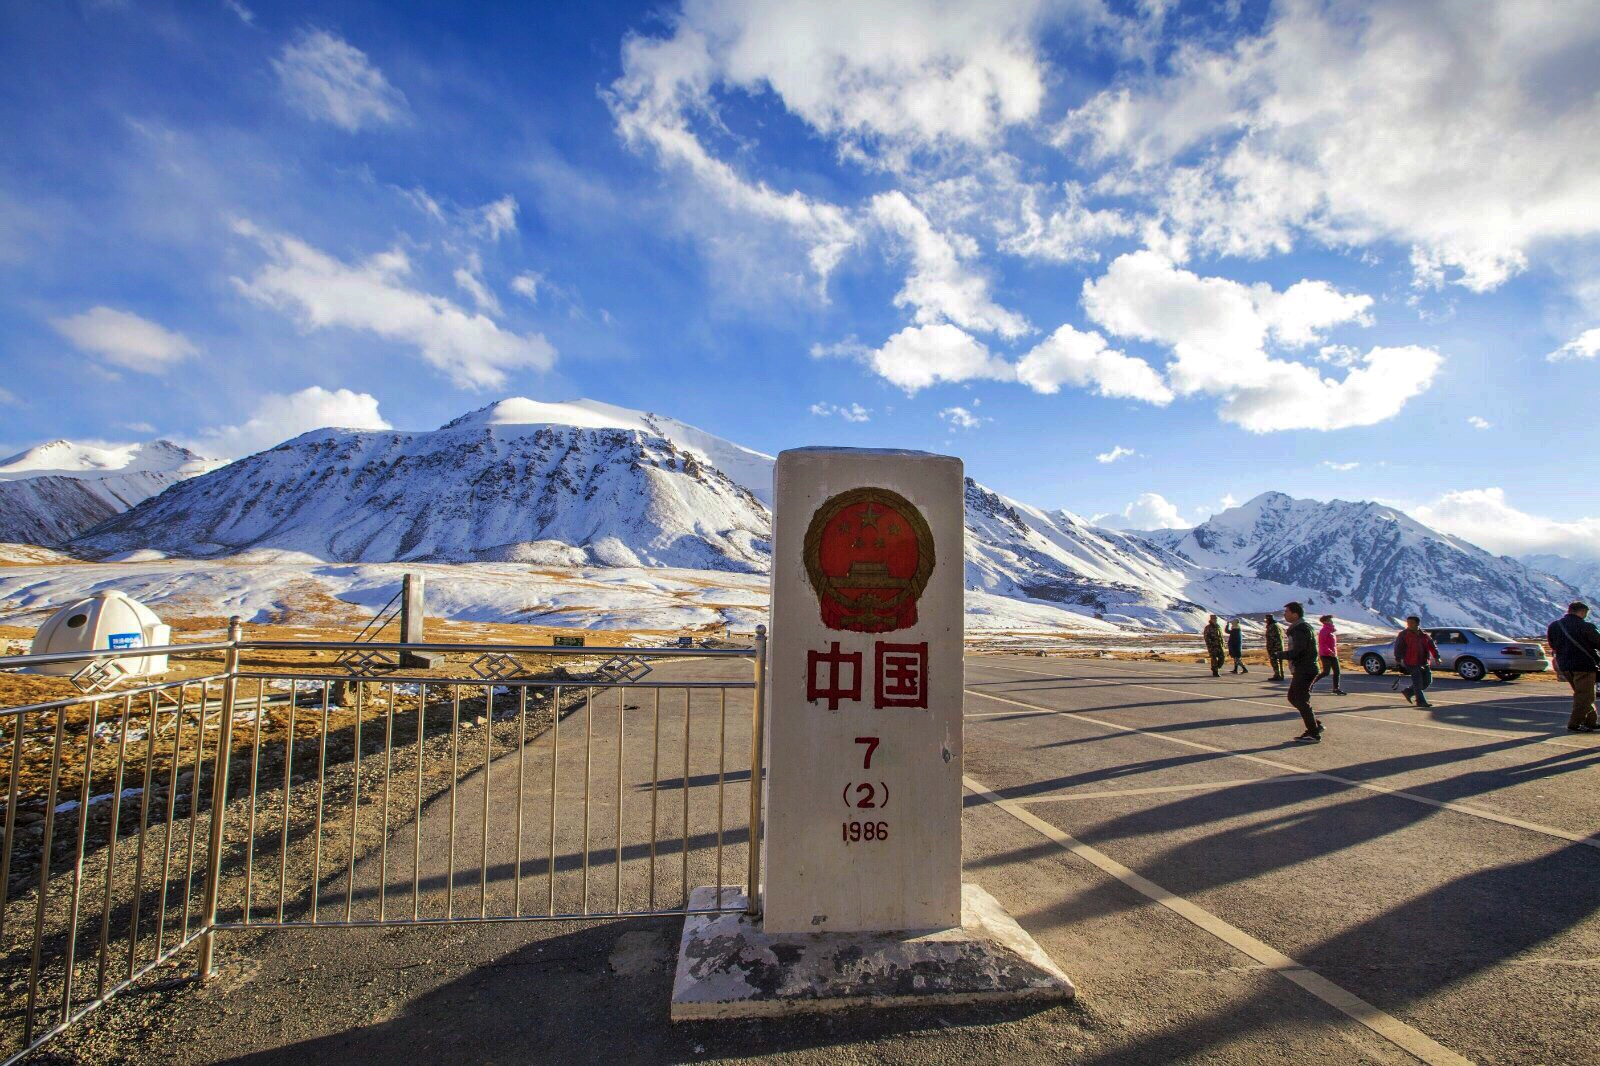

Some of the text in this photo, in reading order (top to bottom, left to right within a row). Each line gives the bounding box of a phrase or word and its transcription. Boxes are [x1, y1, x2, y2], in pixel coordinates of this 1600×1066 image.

[807, 641, 928, 710] 中国
[855, 737, 880, 769] 7
[843, 782, 889, 808] (2)
[842, 821, 888, 842] 1986
